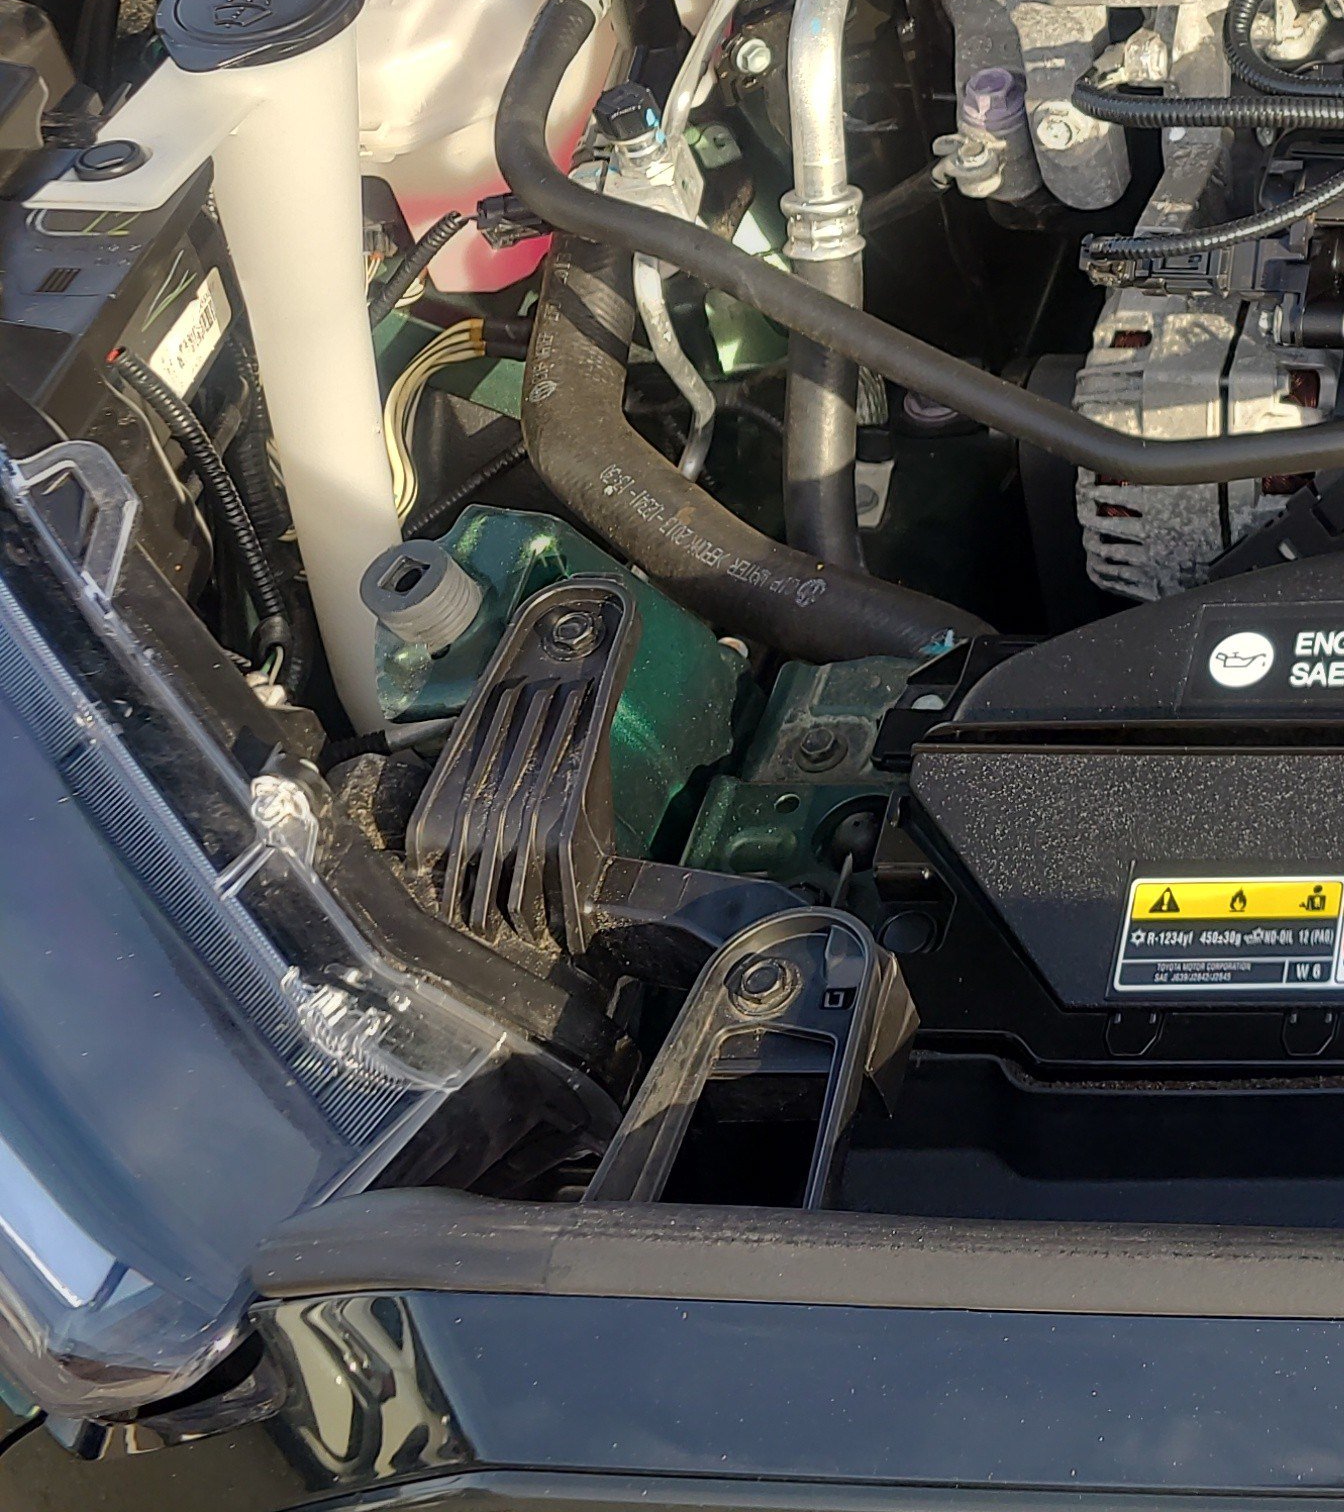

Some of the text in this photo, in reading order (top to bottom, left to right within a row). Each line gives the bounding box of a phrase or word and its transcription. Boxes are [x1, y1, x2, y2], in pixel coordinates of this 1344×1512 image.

[1147, 930, 1194, 949] R-1234yf
[1154, 973, 1168, 982] SAE
[1157, 963, 1181, 971] TOYOTA
[1182, 963, 1205, 971] MOTOR
[1206, 962, 1251, 971] CORPORATION
[1297, 964, 1310, 980] W
